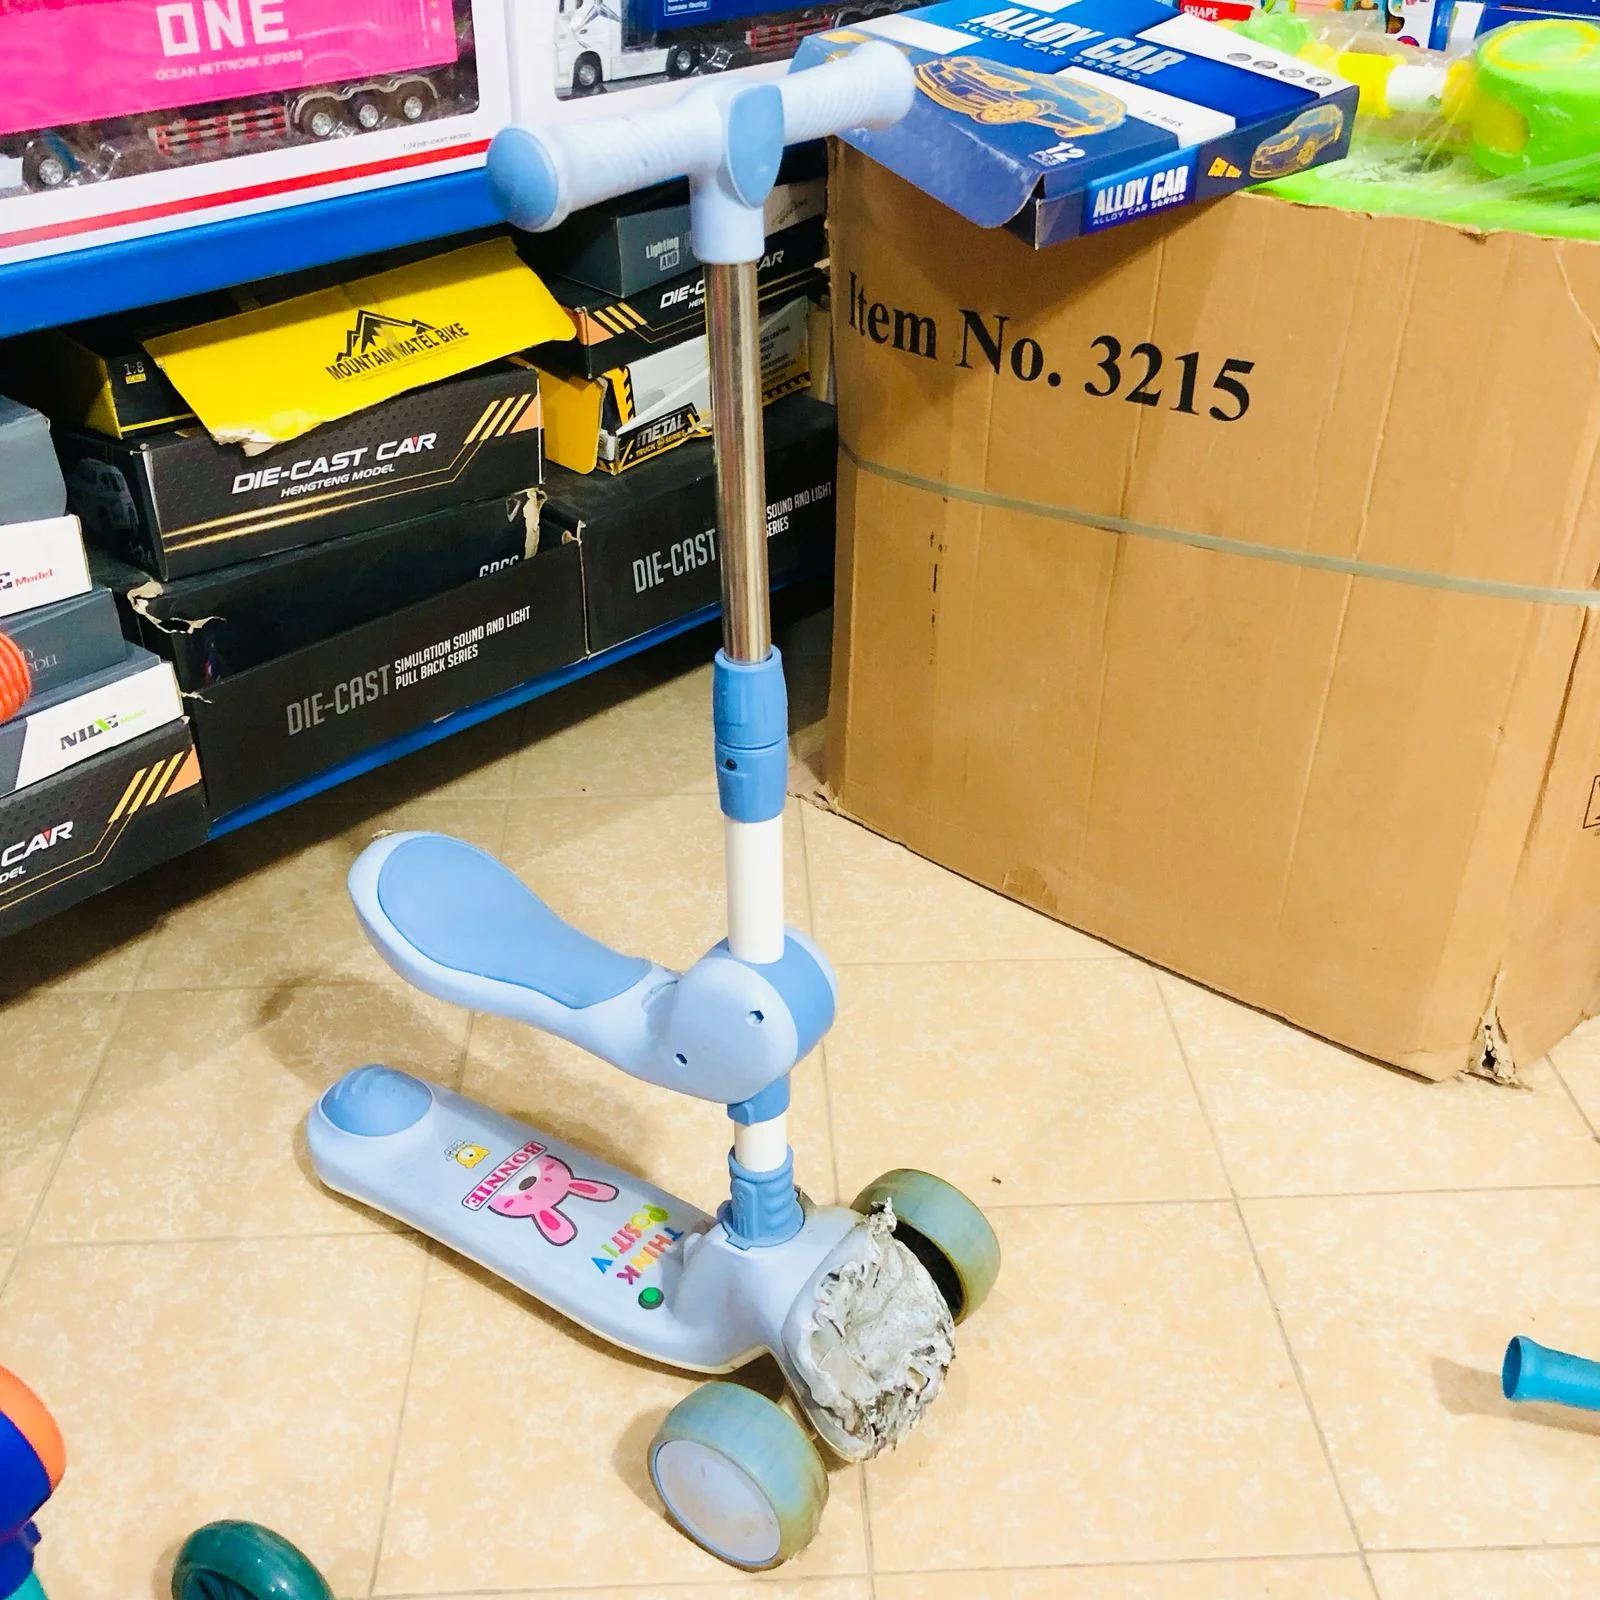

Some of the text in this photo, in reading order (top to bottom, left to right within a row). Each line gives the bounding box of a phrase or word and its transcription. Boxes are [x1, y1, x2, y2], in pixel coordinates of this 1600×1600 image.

[156, 0, 289, 56] ONE
[1184, 5, 1219, 19] SHAPE
[955, 22, 1021, 42] ALLOY
[1022, 41, 1066, 57] CAR
[968, 8, 1187, 75] ALLOY CAR
[155, 64, 197, 81] OCEAN
[1045, 142, 1085, 162] 12
[1092, 165, 1189, 218] ALLOY CAR
[1092, 211, 1125, 226] ALLOY
[1127, 203, 1148, 216] CAR
[645, 236, 679, 259] Lighting
[660, 250, 680, 271] AND
[660, 280, 706, 309] DIE-C
[757, 250, 785, 272] AR
[123, 361, 145, 375] 1:8
[325, 344, 399, 381] MOUNTAIN
[399, 331, 440, 358] MATEL
[435, 322, 470, 344] BIKE
[849, 271, 938, 361] Item
[955, 309, 1061, 388] No.
[1083, 334, 1256, 422] 3215
[636, 414, 686, 447] METAL
[231, 432, 437, 494] DIE-CAST CAR
[280, 463, 395, 498] HENGTENG MODEL
[766, 481, 832, 520] SOUND AND LIGHT
[632, 528, 716, 594] DIE-CAST
[394, 605, 531, 675] SIMULATION SOUND AND LIGHT
[395, 643, 479, 690] PULL BACK SERIES
[286, 664, 391, 736] DIE-CAST
[1, 820, 74, 867] CAR
[464, 1142, 544, 1208] BONNIE
[616, 1227, 684, 1286] THINK
